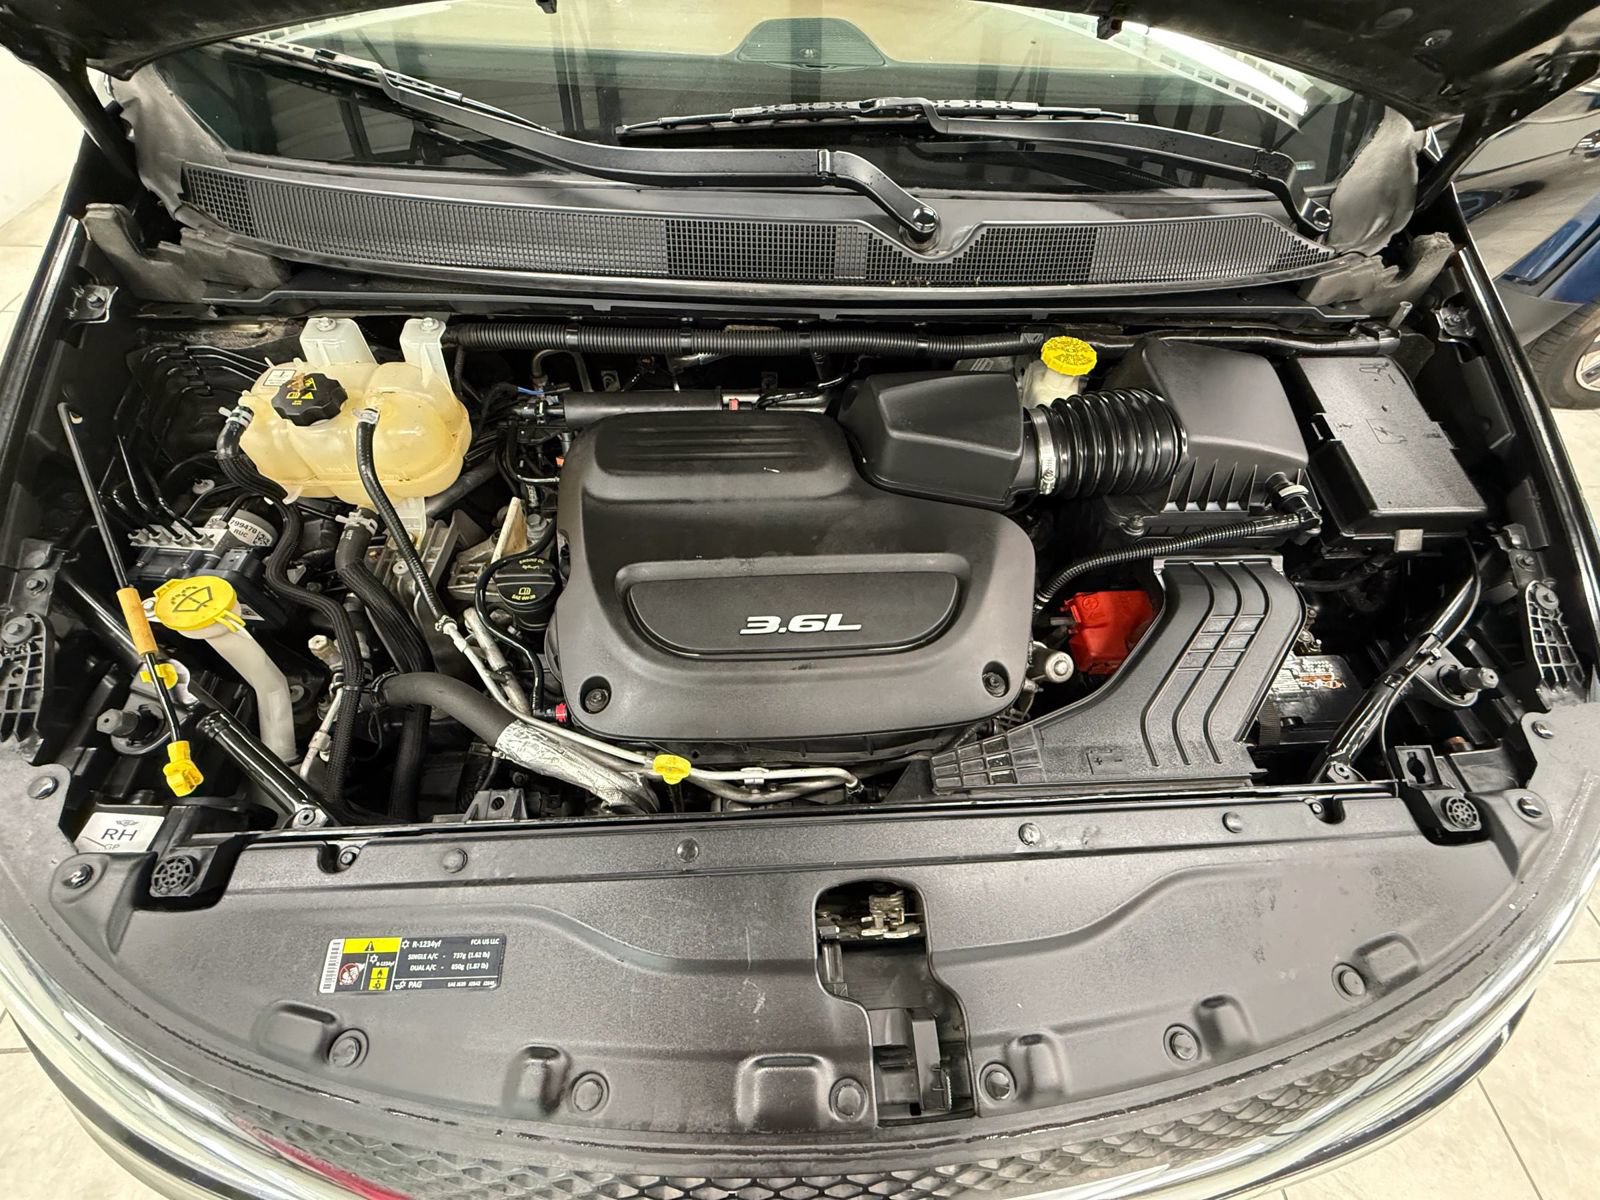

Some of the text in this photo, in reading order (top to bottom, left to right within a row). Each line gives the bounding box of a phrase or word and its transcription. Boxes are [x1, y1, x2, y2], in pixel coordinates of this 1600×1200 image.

[739, 613, 862, 635] 3.6L
[101, 828, 138, 841] RH
[412, 939, 442, 949] R-1234yf
[408, 981, 423, 989] PAG
